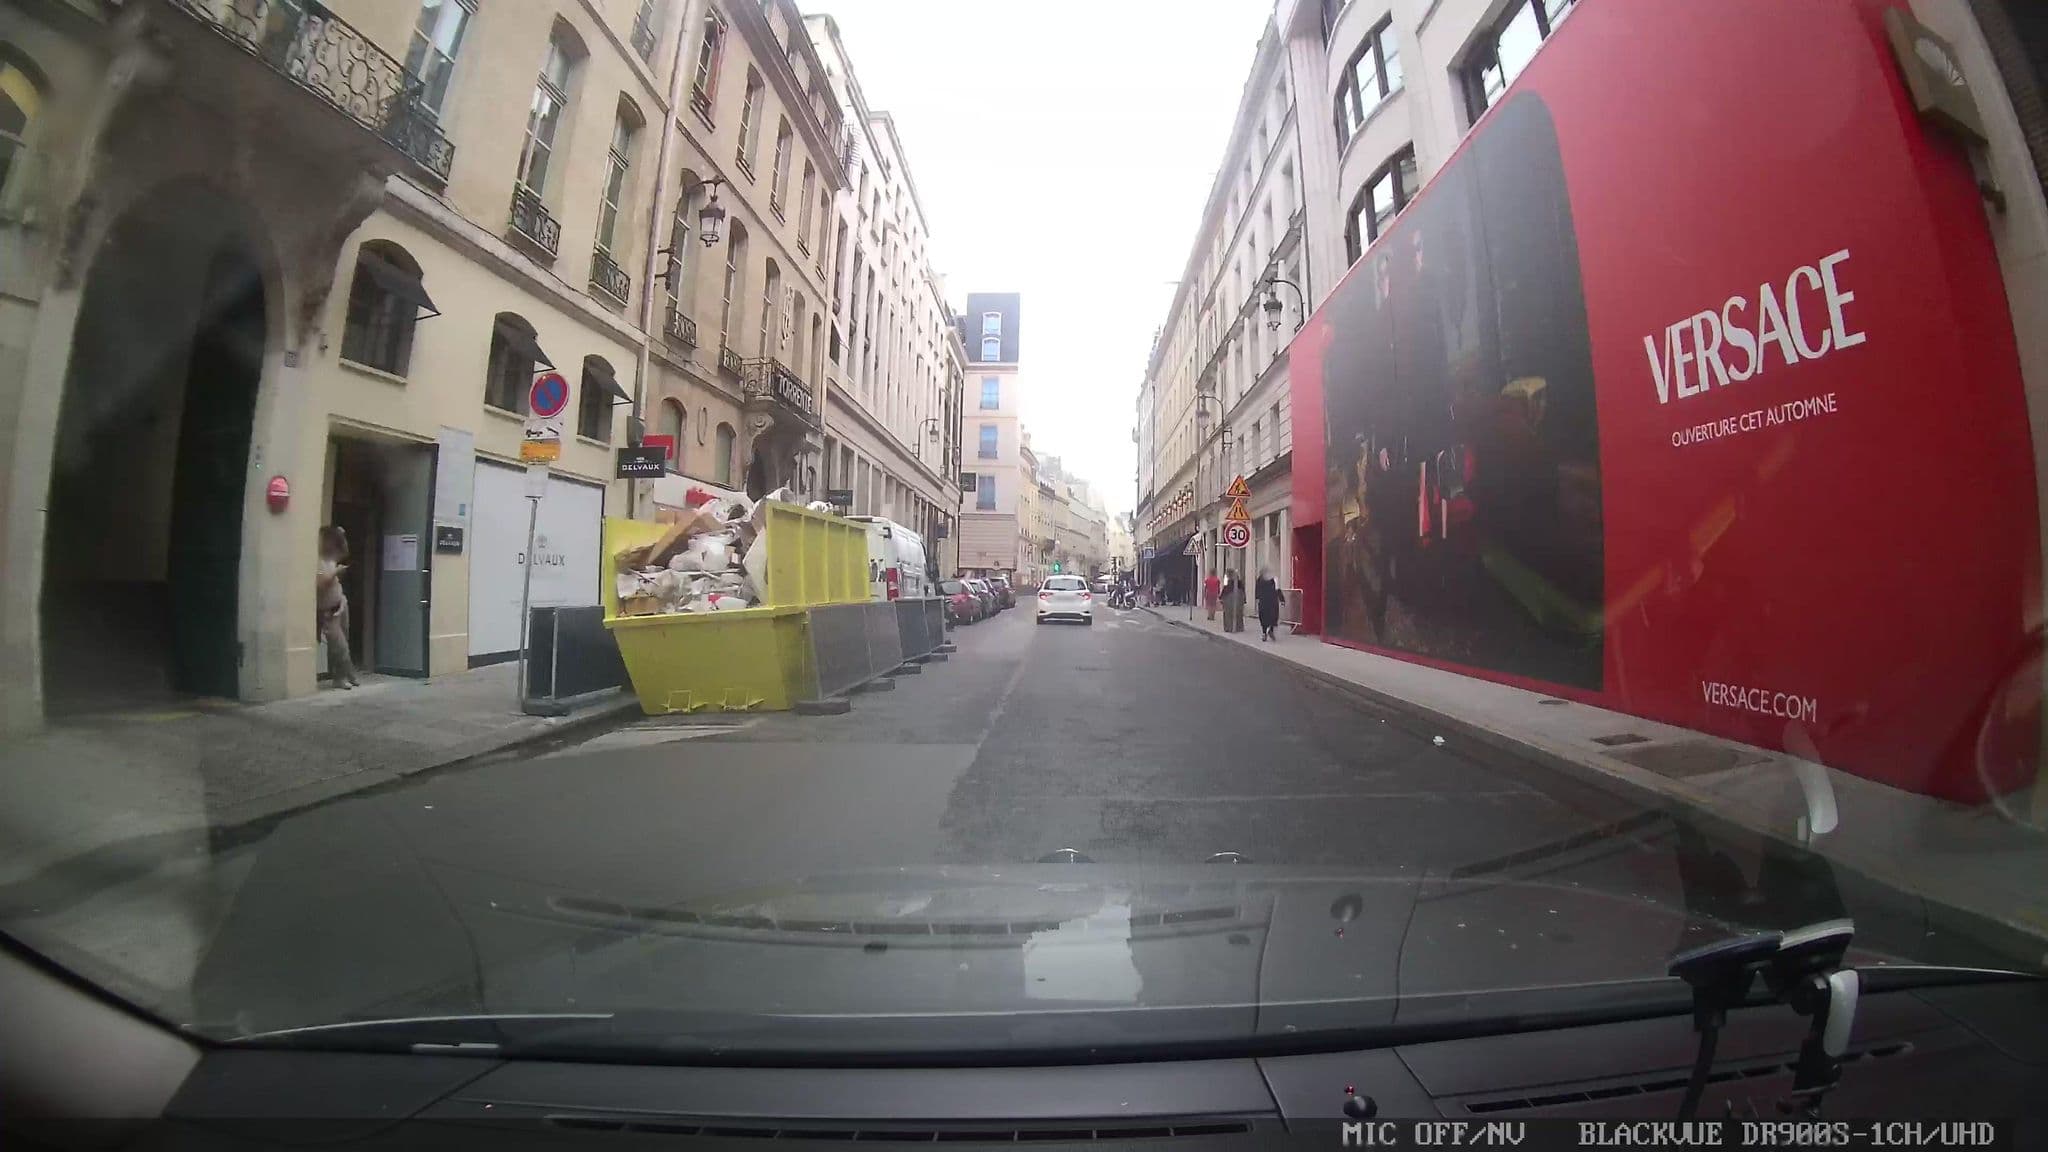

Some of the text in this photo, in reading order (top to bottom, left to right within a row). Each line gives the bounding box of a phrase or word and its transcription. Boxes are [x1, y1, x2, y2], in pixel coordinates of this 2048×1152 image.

[1644, 249, 1866, 404] VERSACE
[778, 374, 812, 415] TORRENTE
[1671, 393, 1838, 447] OUVERTURE CET AUTOMNE
[622, 463, 660, 471] DELVAUX
[1230, 528, 1246, 541] 30
[518, 552, 565, 566] DLVAUX
[1702, 680, 1817, 723] VERSACE.COM
